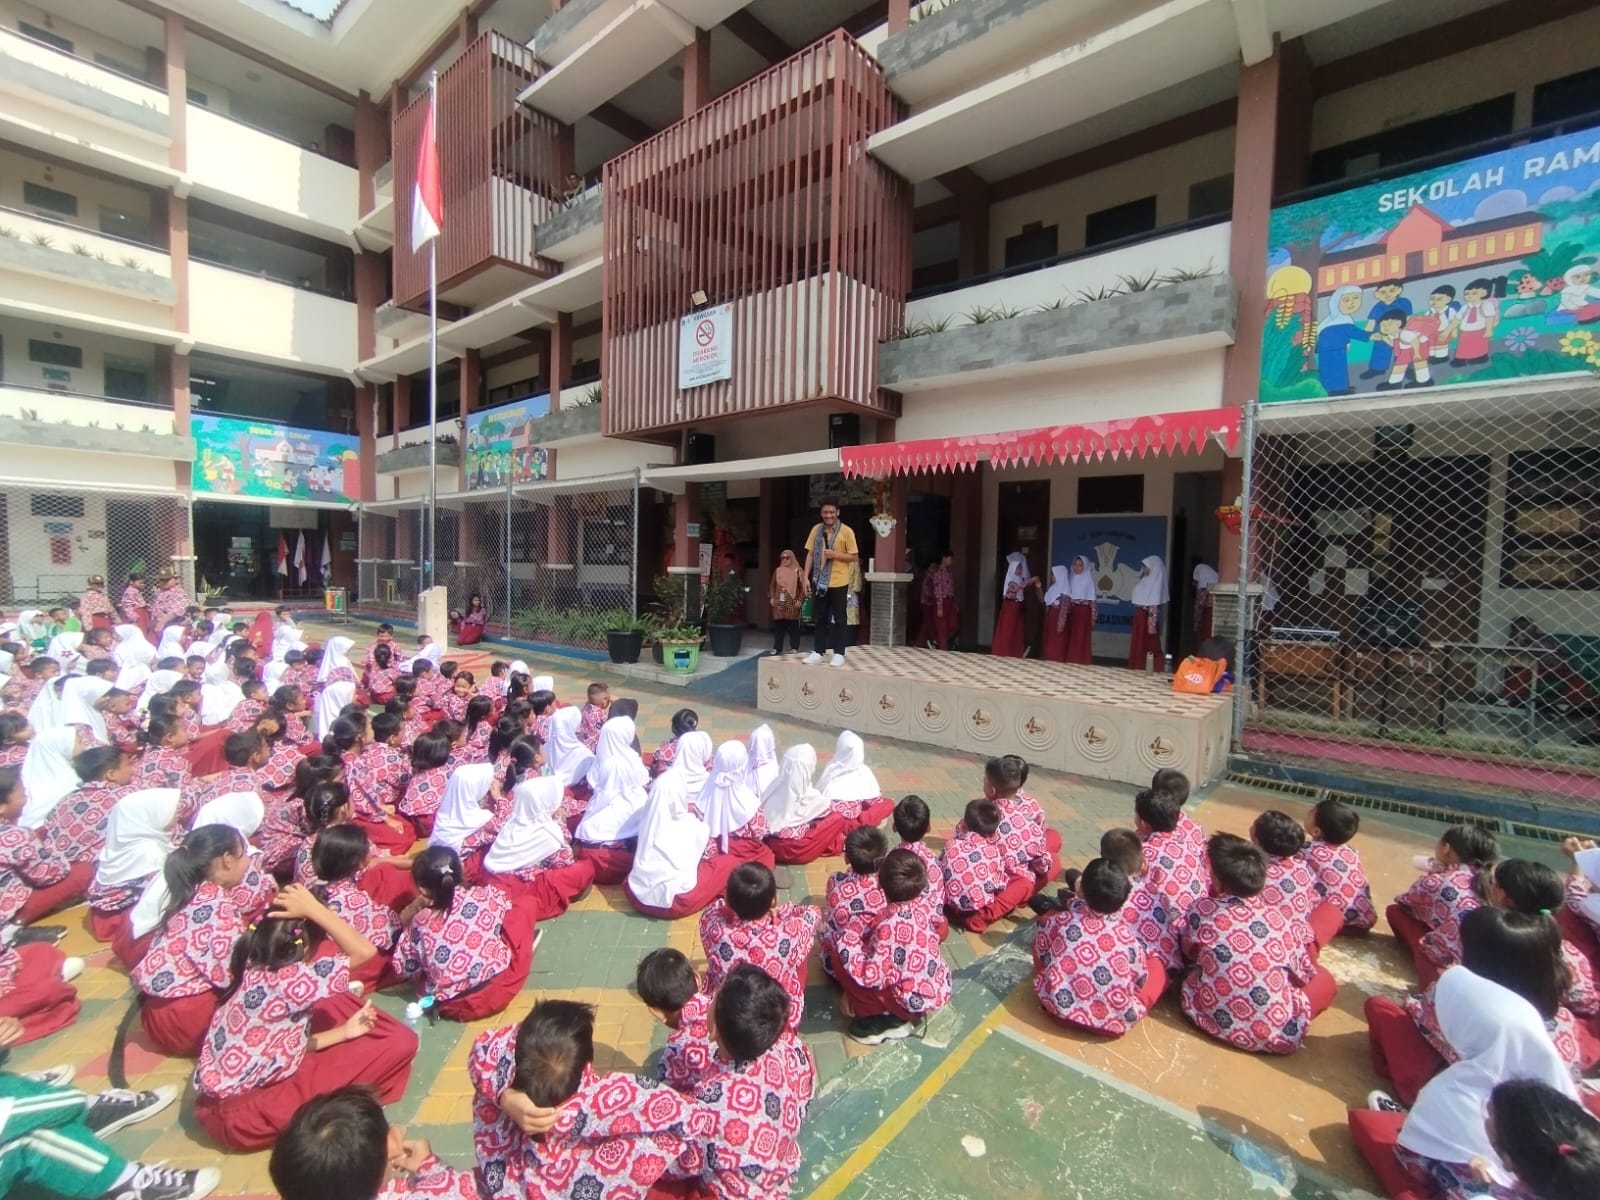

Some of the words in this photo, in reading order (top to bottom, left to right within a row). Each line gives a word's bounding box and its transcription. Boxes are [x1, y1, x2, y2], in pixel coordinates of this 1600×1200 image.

[1378, 166, 1504, 213] SEKOLAH
[692, 346, 718, 358] DILARANG
[692, 353, 718, 364] MEROKOK
